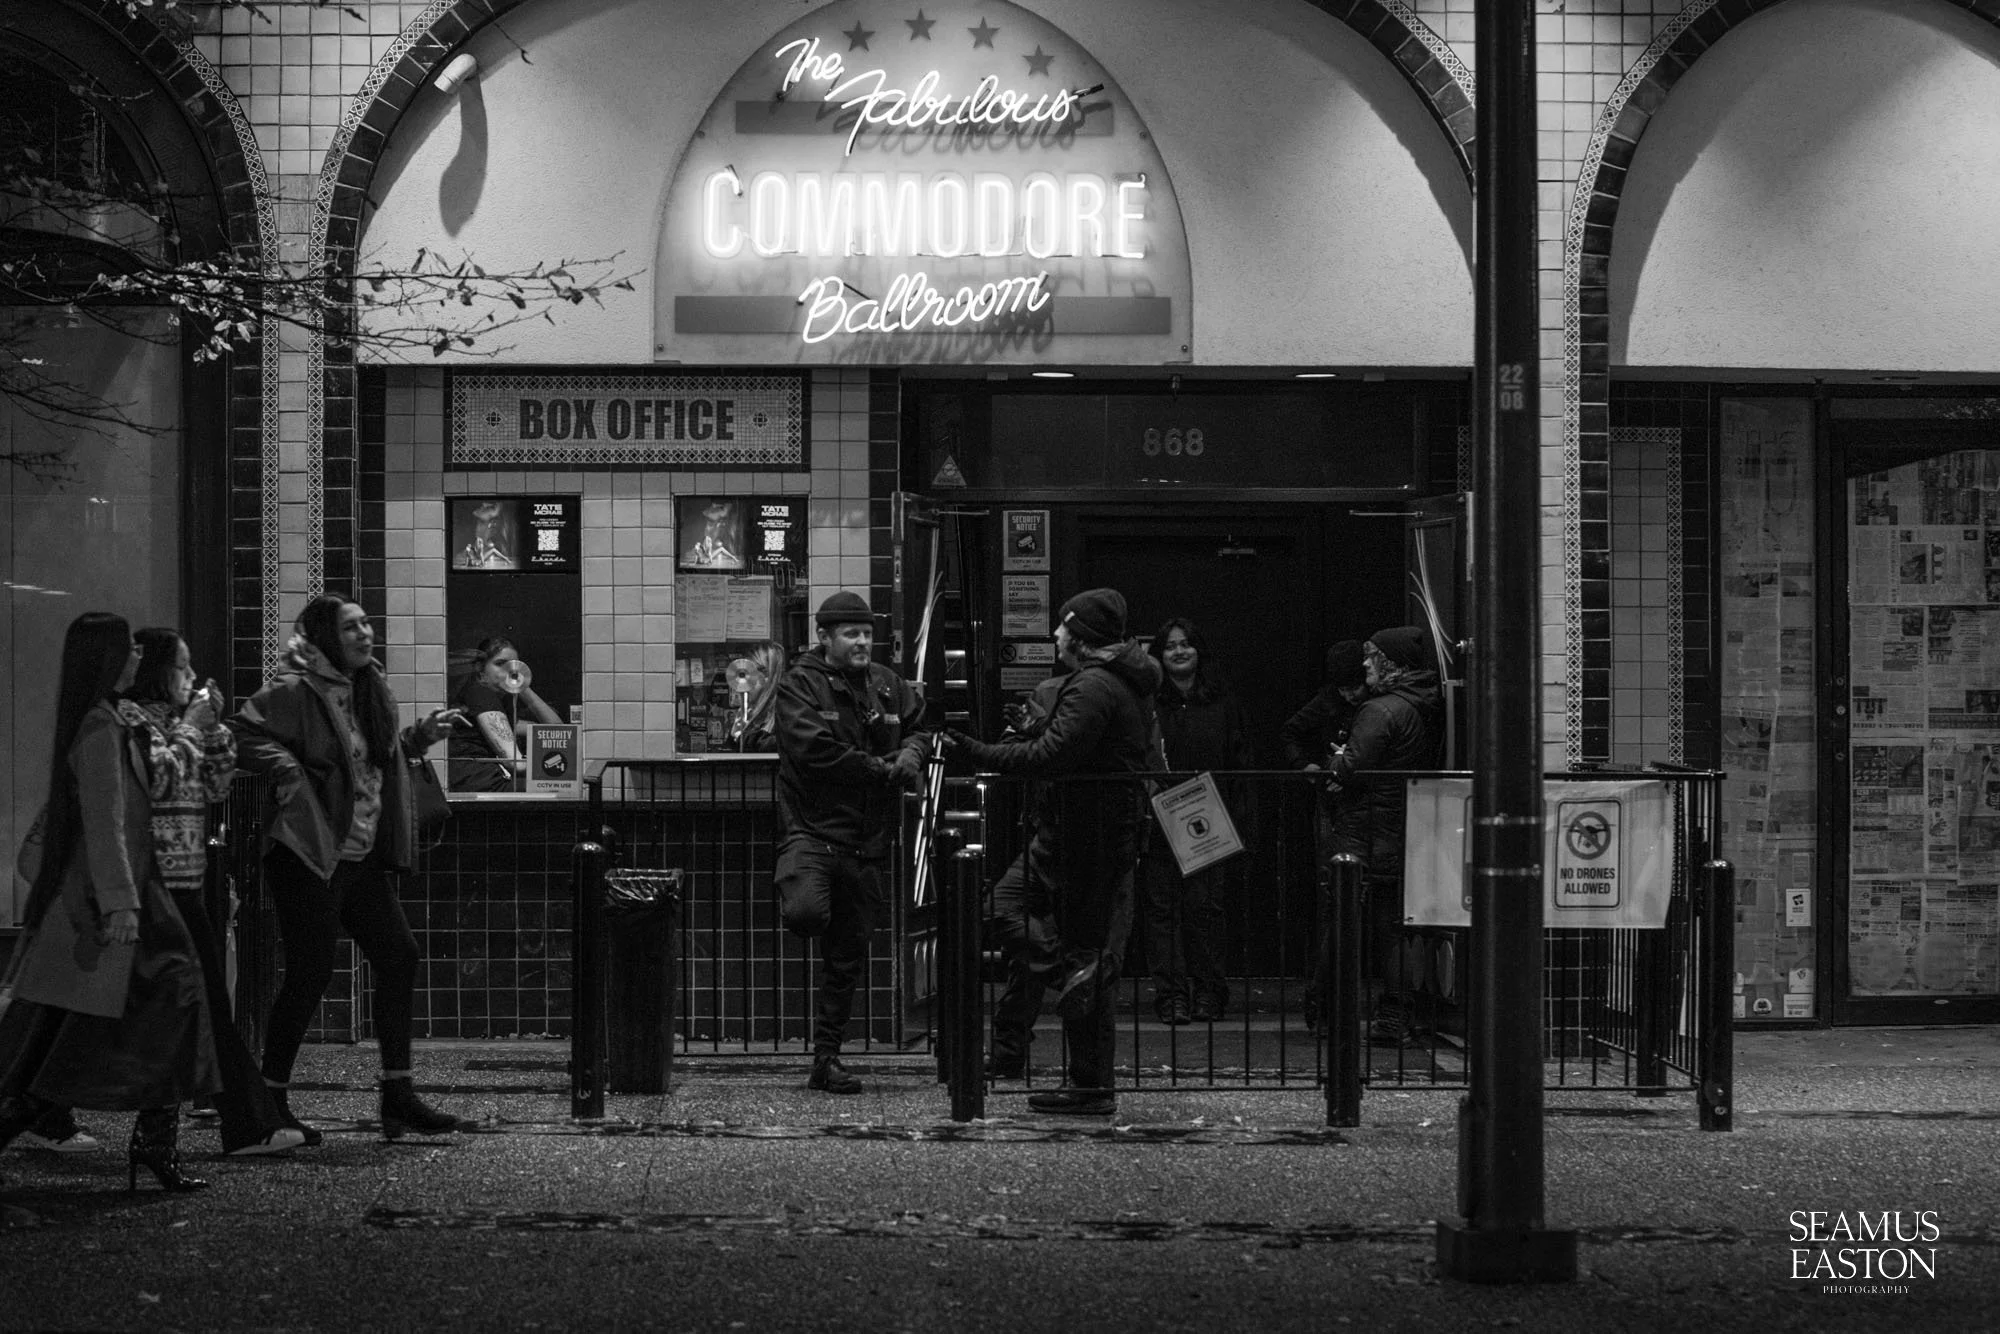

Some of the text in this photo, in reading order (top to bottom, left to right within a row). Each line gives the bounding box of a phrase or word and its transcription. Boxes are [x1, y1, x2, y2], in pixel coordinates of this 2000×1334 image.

[775, 37, 844, 93] The
[824, 69, 1078, 157] Fabulous
[702, 171, 1147, 260] COMMODORE
[798, 271, 1051, 344] Ballroom
[1499, 364, 1524, 384] 22
[1500, 391, 1524, 411] 08
[519, 398, 735, 441] BOX OFFICE
[1142, 427, 1204, 457] 868
[533, 503, 563, 511] TATE
[1011, 515, 1041, 524] SECURITY
[1015, 523, 1037, 531] NOTICE
[537, 730, 572, 739] SECURITY
[542, 739, 568, 749] NOTICE
[1560, 867, 1616, 880] NO DRONES
[1564, 882, 1611, 895] ALLOWED
